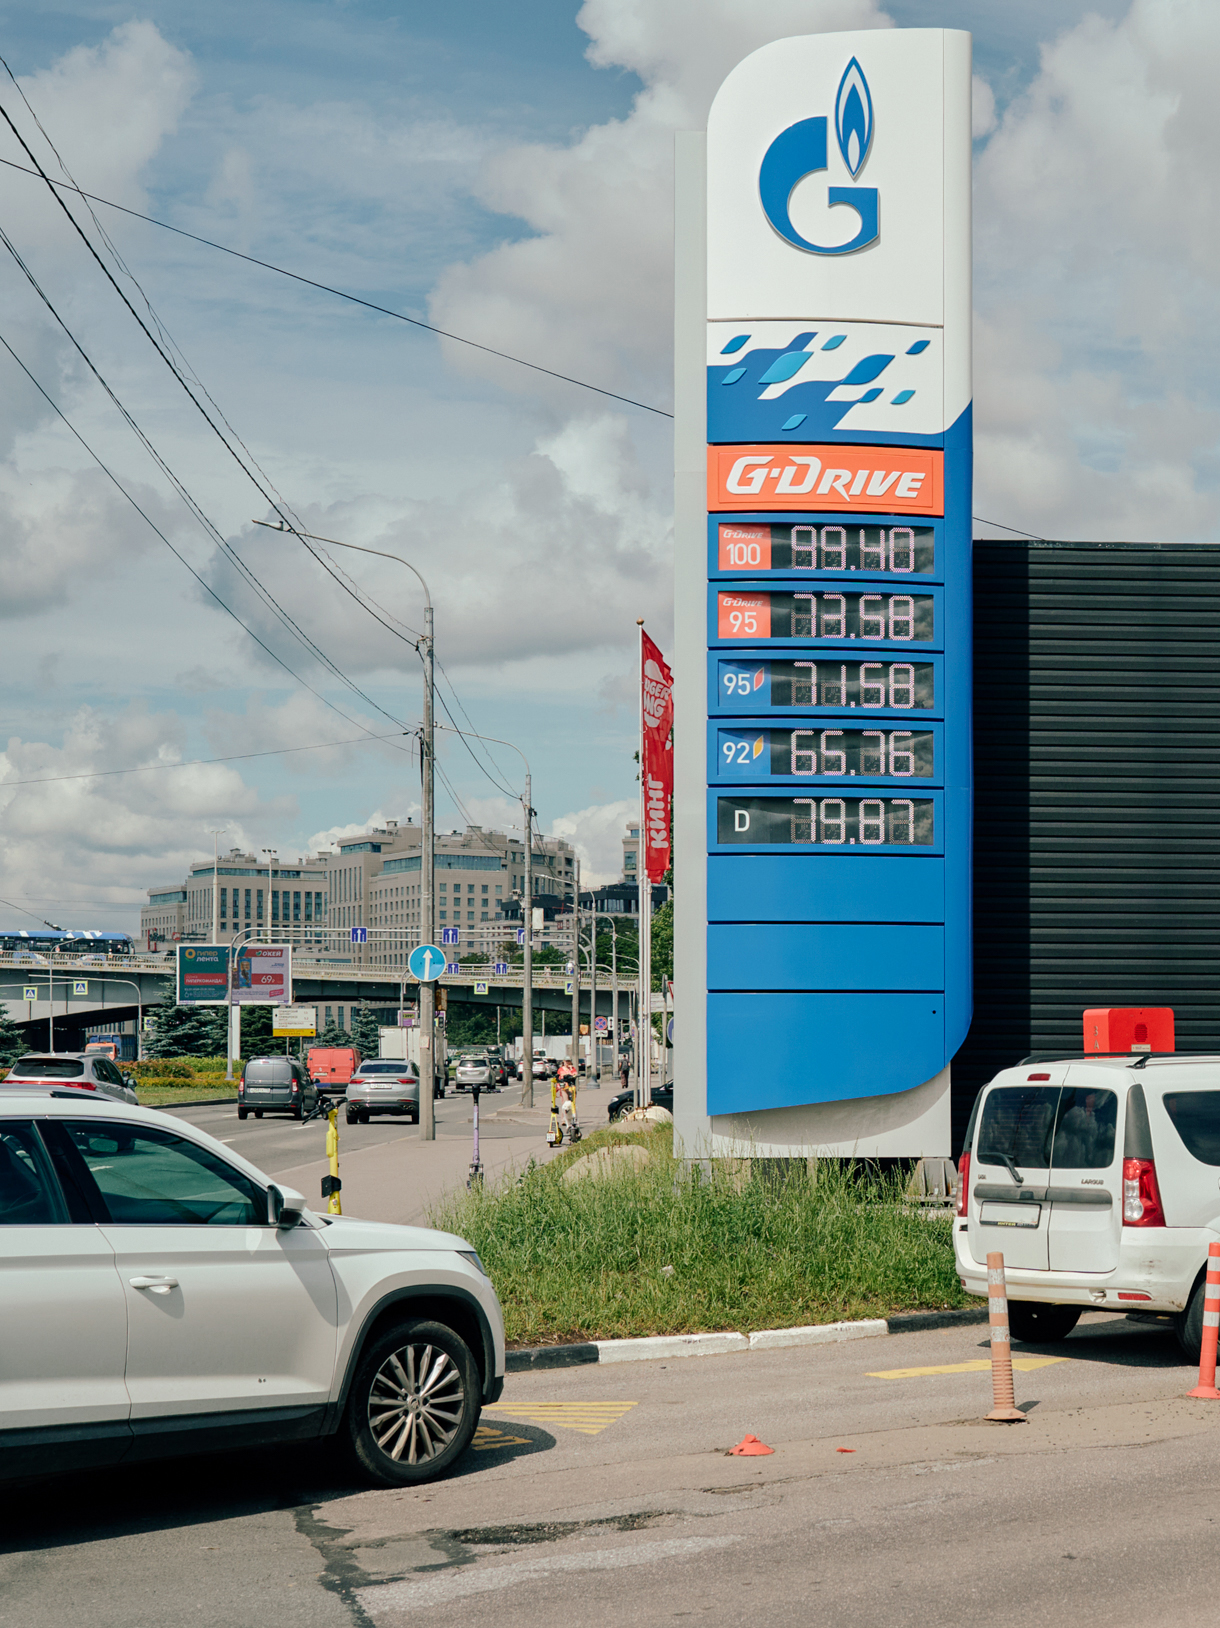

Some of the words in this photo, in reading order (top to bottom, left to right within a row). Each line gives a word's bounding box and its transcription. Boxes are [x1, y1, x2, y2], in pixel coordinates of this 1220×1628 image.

[726, 543, 761, 565] 100
[791, 525, 915, 573] 99.40
[729, 611, 757, 633] 95
[793, 594, 915, 641] 73.58
[723, 673, 751, 696] 95
[793, 662, 915, 709] 71.58
[722, 741, 750, 764] 92
[791, 730, 915, 777] 65.76
[648, 773, 669, 848] КИНГ
[734, 809, 750, 832] D
[792, 798, 915, 845] 79.87
